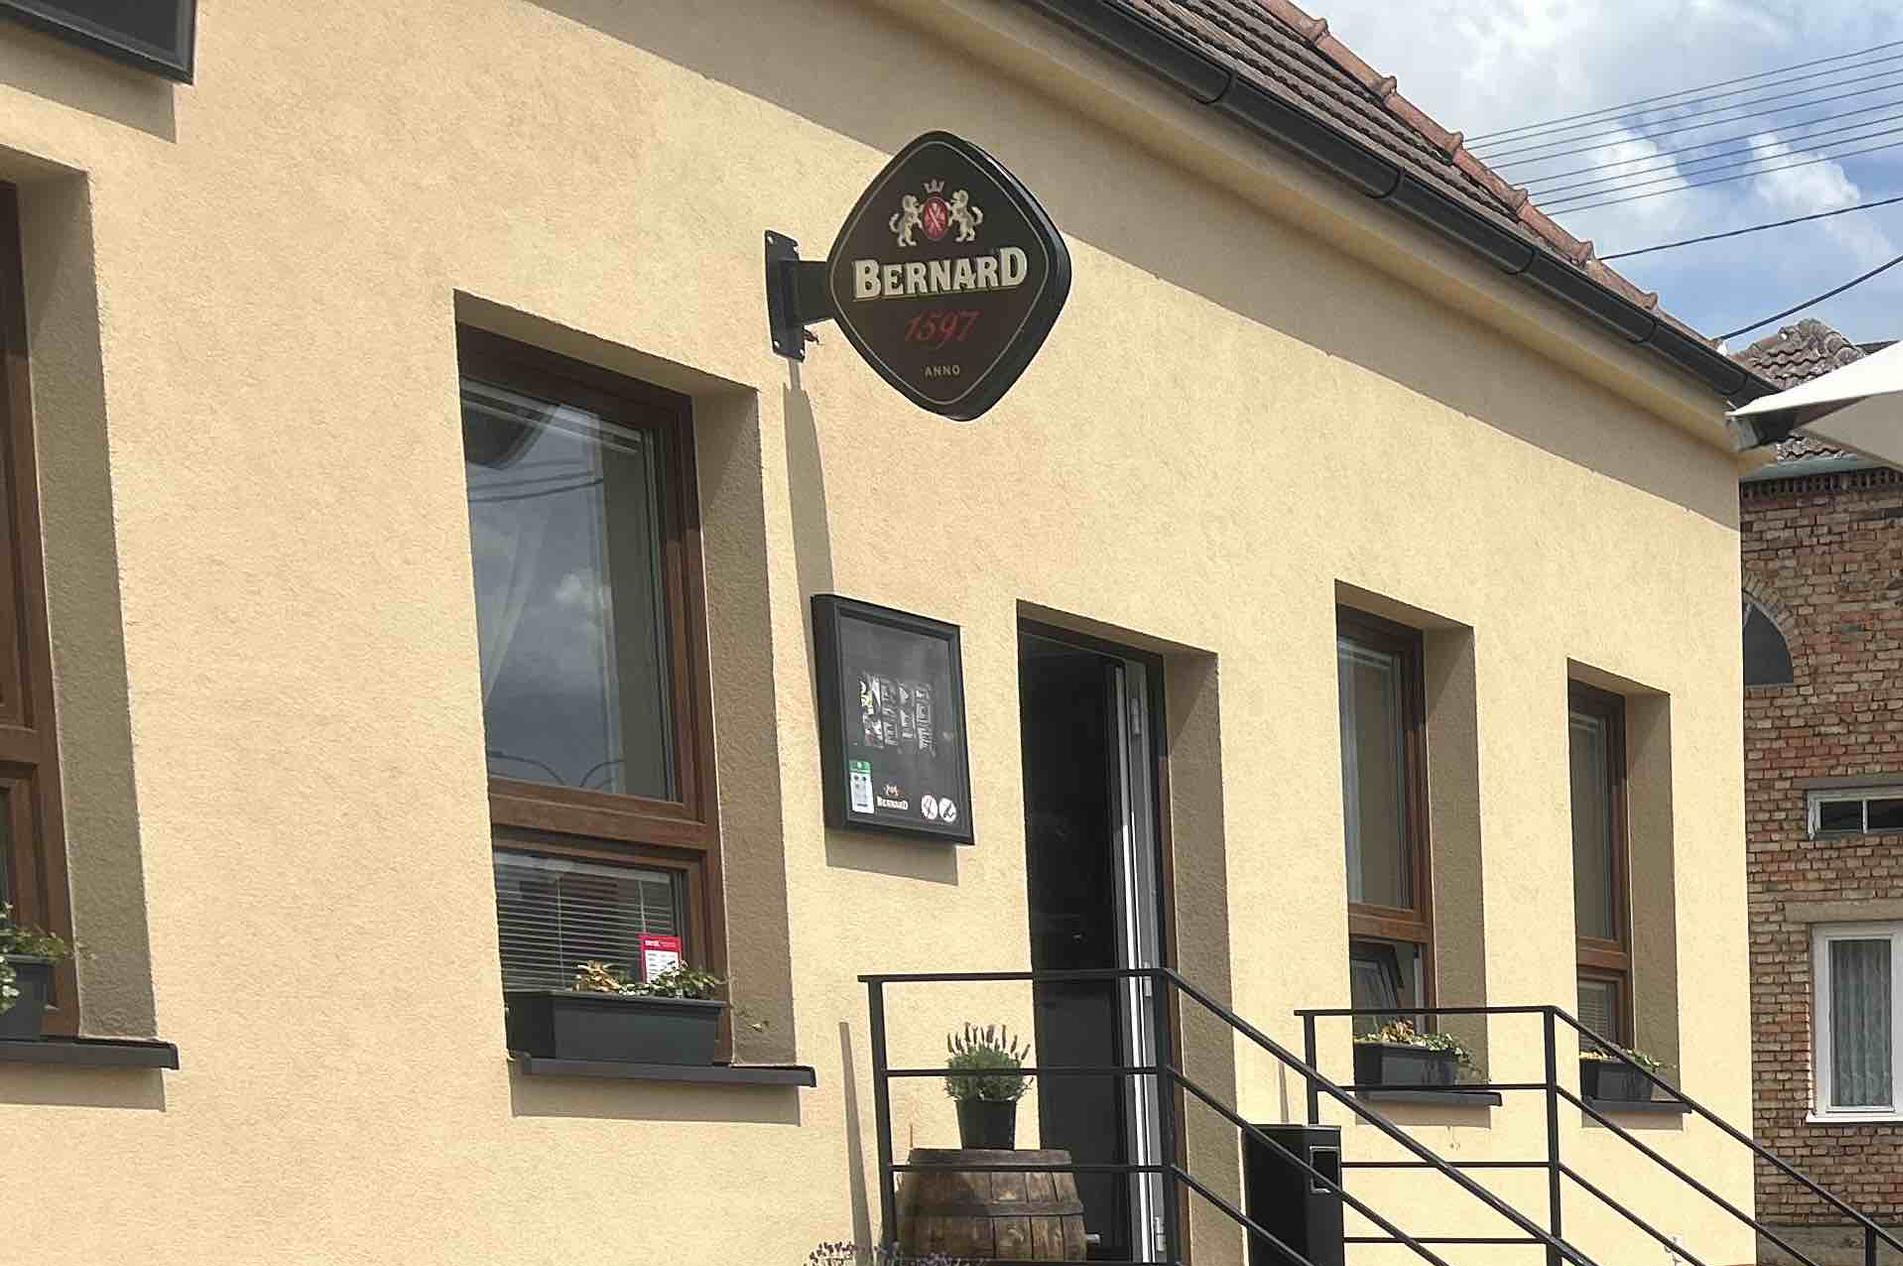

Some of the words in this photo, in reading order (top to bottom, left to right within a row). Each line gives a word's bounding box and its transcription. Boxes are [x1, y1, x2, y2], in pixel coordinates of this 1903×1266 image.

[853, 246, 1028, 301] BERNARD
[904, 309, 982, 349] 1597
[924, 364, 961, 378] ANNO
